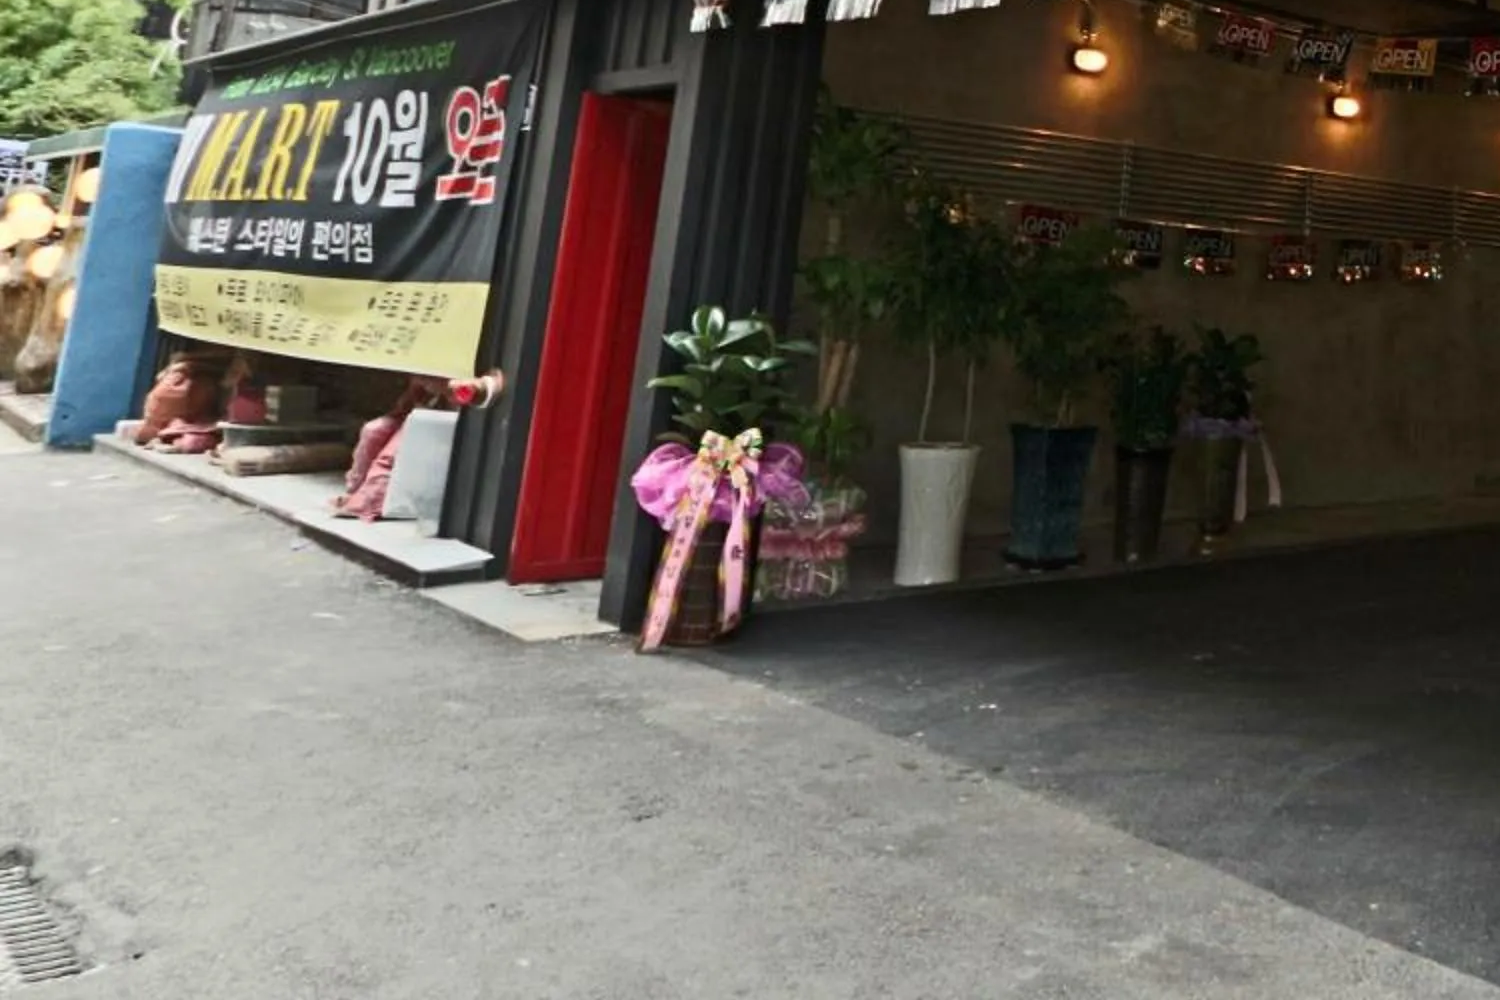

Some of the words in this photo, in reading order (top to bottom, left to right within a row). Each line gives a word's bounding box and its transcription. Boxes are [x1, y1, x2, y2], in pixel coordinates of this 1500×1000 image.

[1225, 23, 1270, 51] OPEN
[1300, 39, 1347, 64] OPEN
[1378, 49, 1429, 70] OPEN
[333, 89, 429, 208] 10월
[312, 220, 374, 264] 편의점
